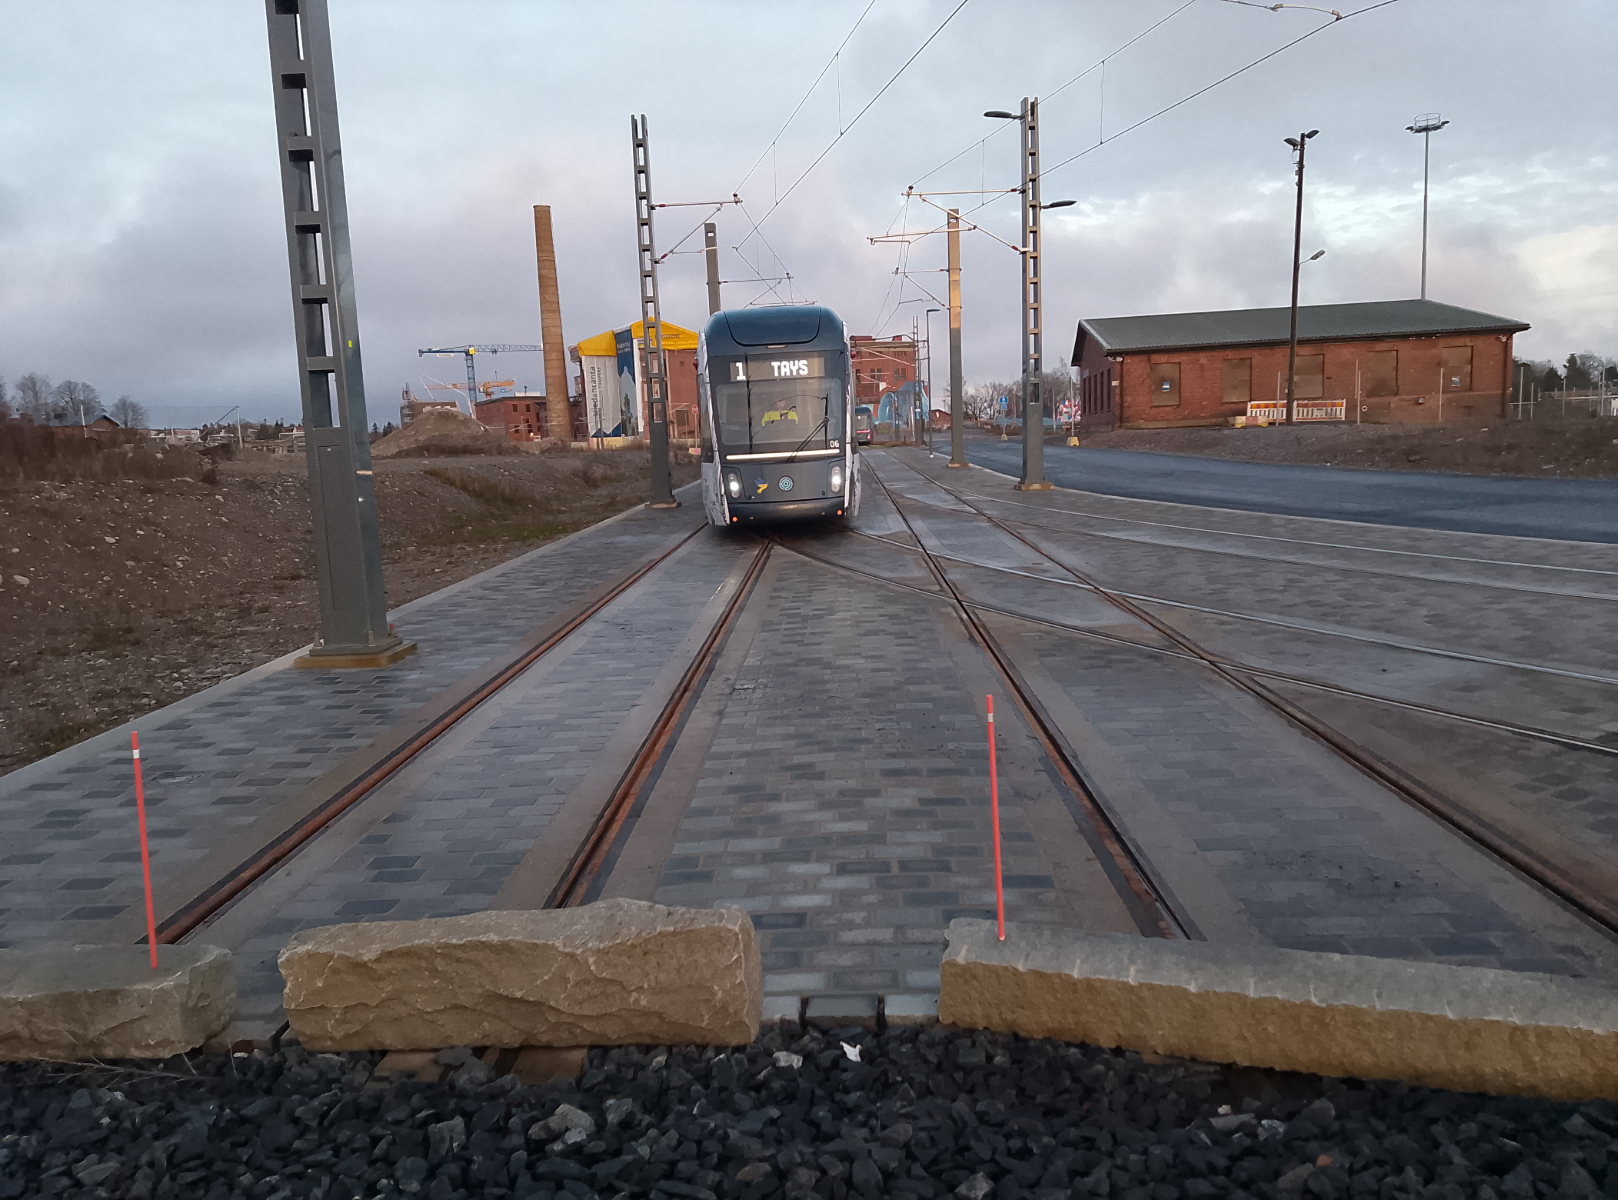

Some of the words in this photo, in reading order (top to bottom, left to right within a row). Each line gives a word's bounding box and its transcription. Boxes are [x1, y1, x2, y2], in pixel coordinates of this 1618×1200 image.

[736, 362, 746, 380] 1
[771, 360, 808, 376] TAYS
[829, 439, 840, 448] 06
